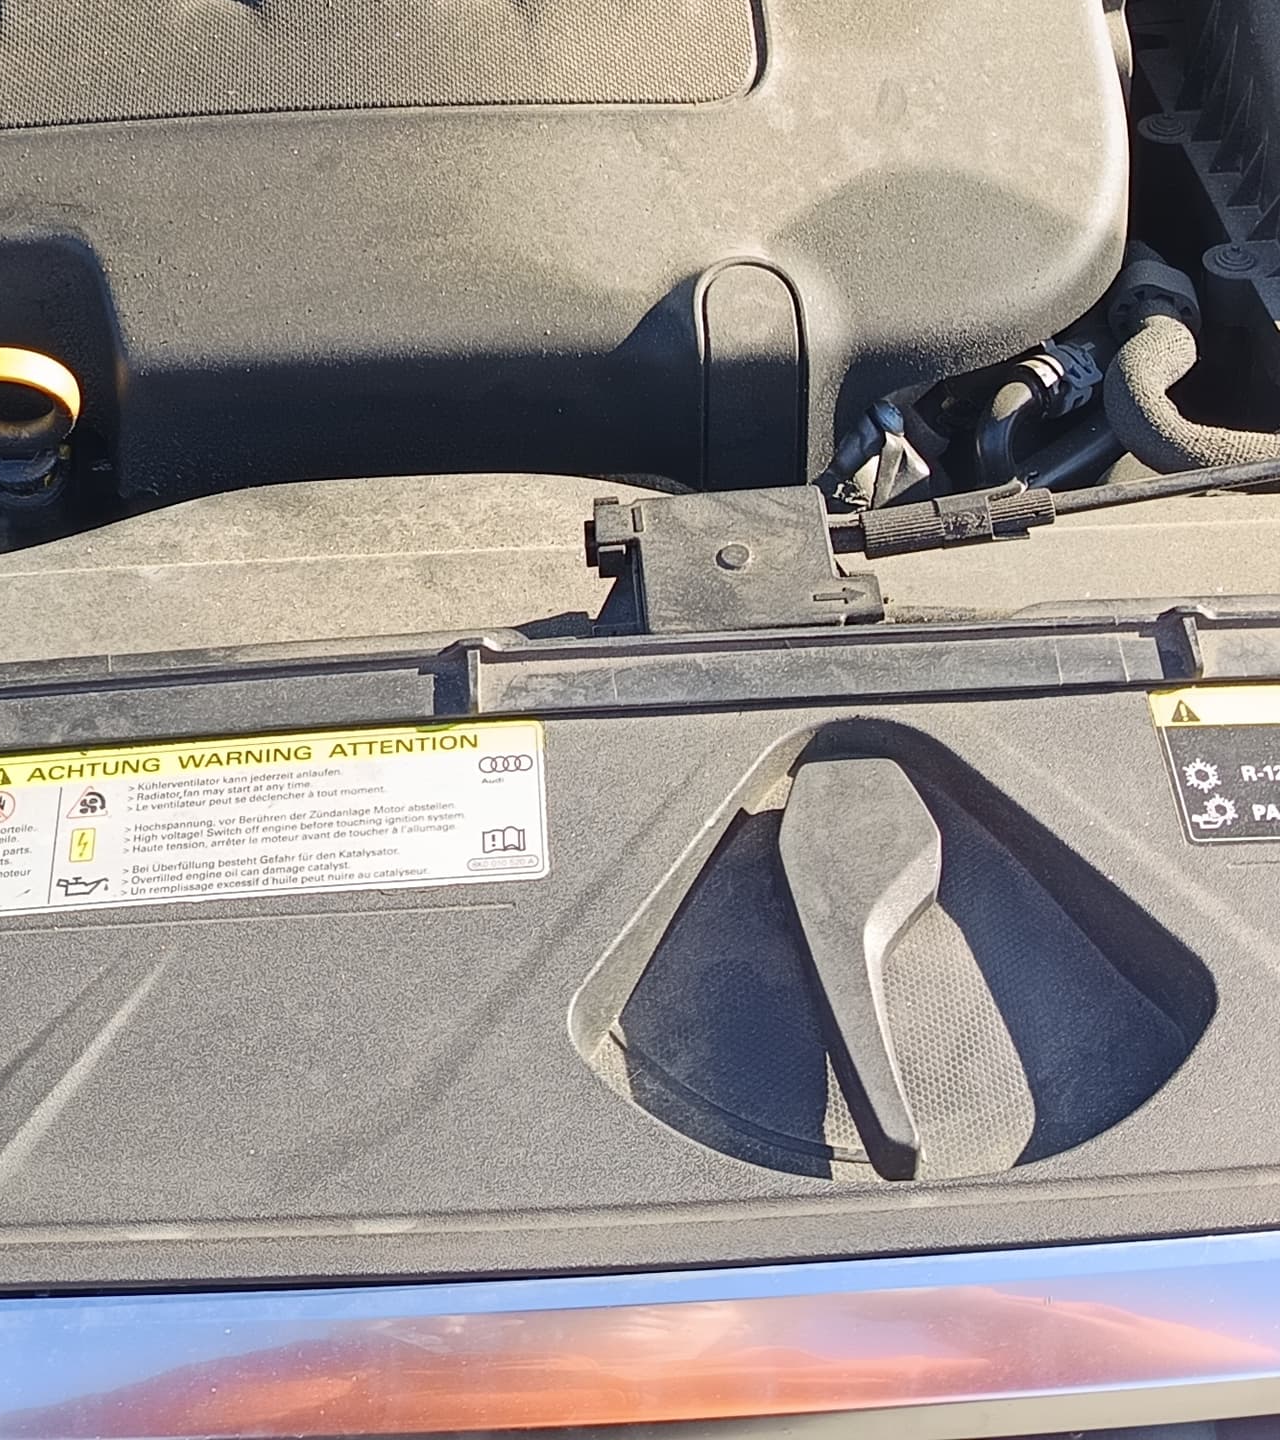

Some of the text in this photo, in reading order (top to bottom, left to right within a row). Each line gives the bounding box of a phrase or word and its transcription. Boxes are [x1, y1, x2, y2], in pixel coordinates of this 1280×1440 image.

[27, 734, 477, 782] ACHTUNG WARNING ATTENTION
[138, 768, 342, 791] Kühlerventilator kann jederzeit anlaufen.
[183, 788, 199, 799] fan
[203, 788, 224, 797] may
[228, 785, 250, 795] start
[253, 784, 263, 793] at
[266, 783, 284, 792] any
[288, 781, 312, 790] time.
[481, 777, 504, 785] Audi
[136, 785, 386, 812] Le ventilateur peut se déclencher à tout moment.
[219, 817, 235, 826] vor
[239, 814, 286, 825] Berühren
[290, 812, 306, 821] der
[309, 807, 370, 820] Zündanlage
[374, 805, 405, 814] Motor
[133, 832, 157, 844] High
[161, 829, 203, 841] voltage!
[207, 826, 242, 838] Switch
[245, 824, 259, 835] off
[262, 823, 297, 834] engine
[300, 820, 333, 831] before
[336, 815, 382, 828] touching
[385, 815, 424, 826] ignition
[133, 843, 163, 854] Haute
[211, 837, 245, 848] arrêter
[249, 835, 258, 845] le
[261, 834, 298, 844] moteur
[302, 831, 330, 841] avant
[333, 830, 346, 839] de
[349, 827, 388, 838] toucher
[392, 826, 398, 835] à
[3, 847, 31, 858] parts.
[132, 864, 149, 875] Bei
[218, 856, 256, 869] besteht
[260, 854, 295, 865] Gefahr
[298, 852, 313, 862] für
[316, 851, 336, 861] den
[339, 848, 399, 859] Katalysator.
[131, 886, 146, 896] Un
[149, 879, 213, 894] remplissage
[217, 876, 259, 889] excessif
[301, 873, 324, 885] peut
[328, 872, 354, 881] nuire
[186, 867, 222, 882] engine
[225, 868, 238, 879] oil
[241, 868, 259, 877] can
[262, 865, 305, 876] damage
